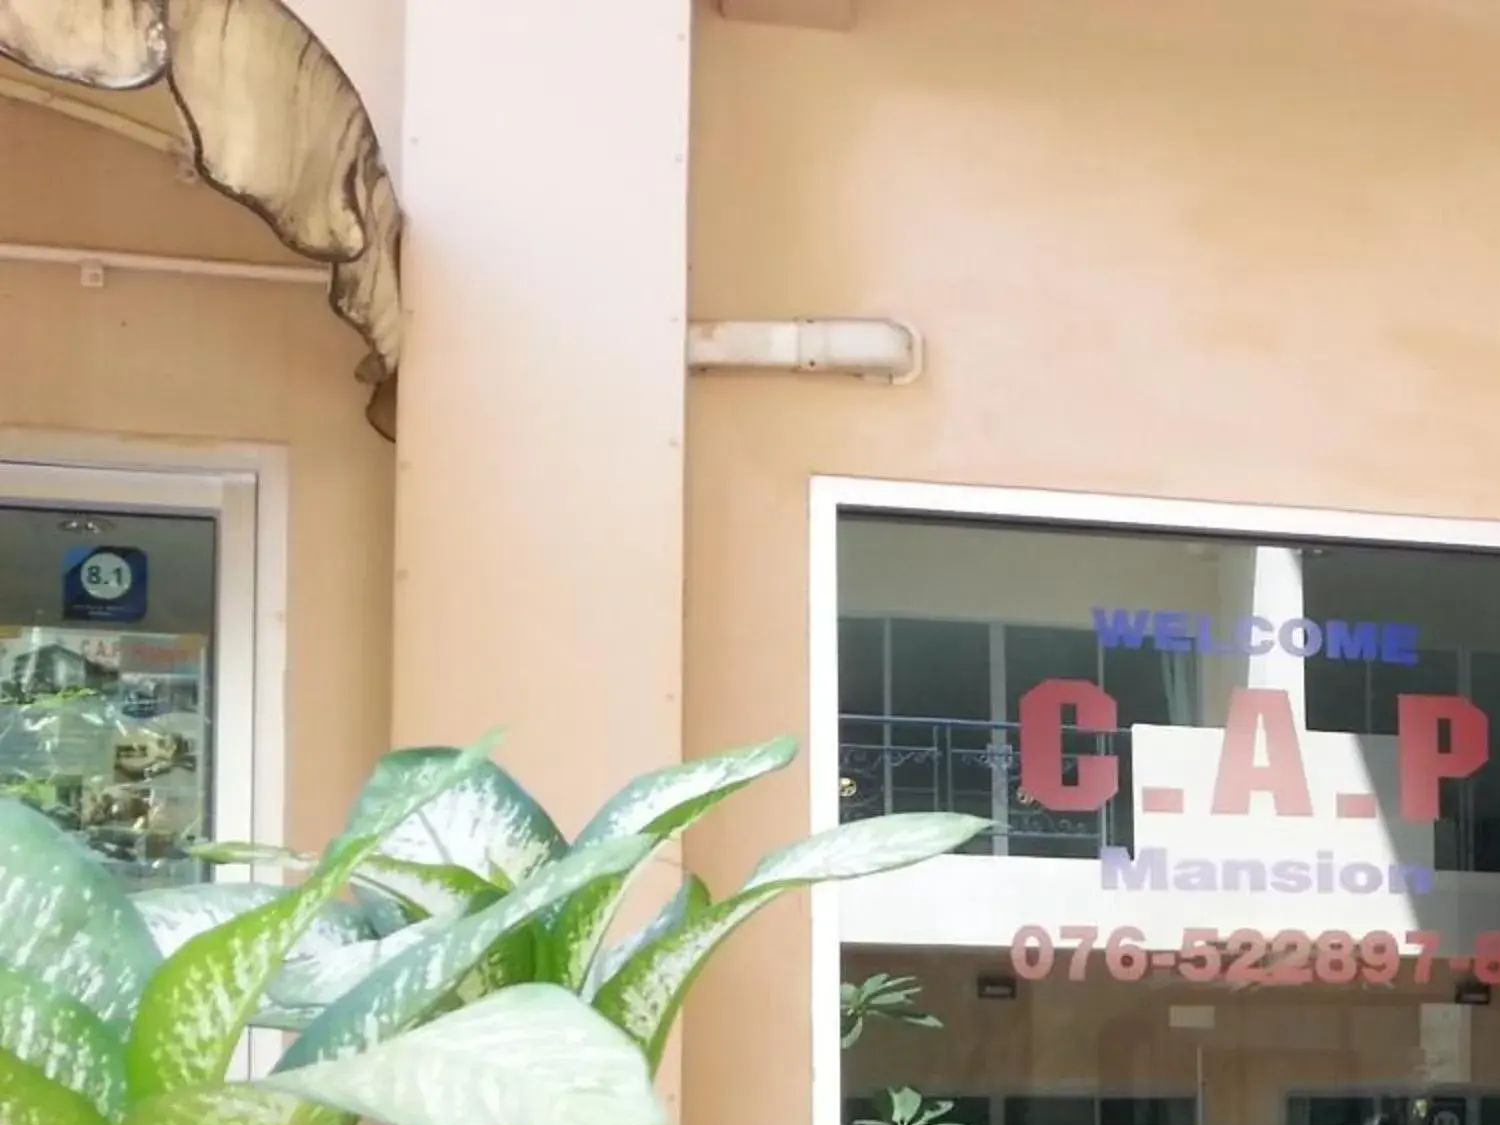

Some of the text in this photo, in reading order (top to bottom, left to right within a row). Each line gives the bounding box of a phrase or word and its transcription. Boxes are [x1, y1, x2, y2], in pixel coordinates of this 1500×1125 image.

[86, 565, 123, 586] 8.1
[1093, 608, 1418, 665] WELCOME
[1100, 846, 1432, 895] Mansion
